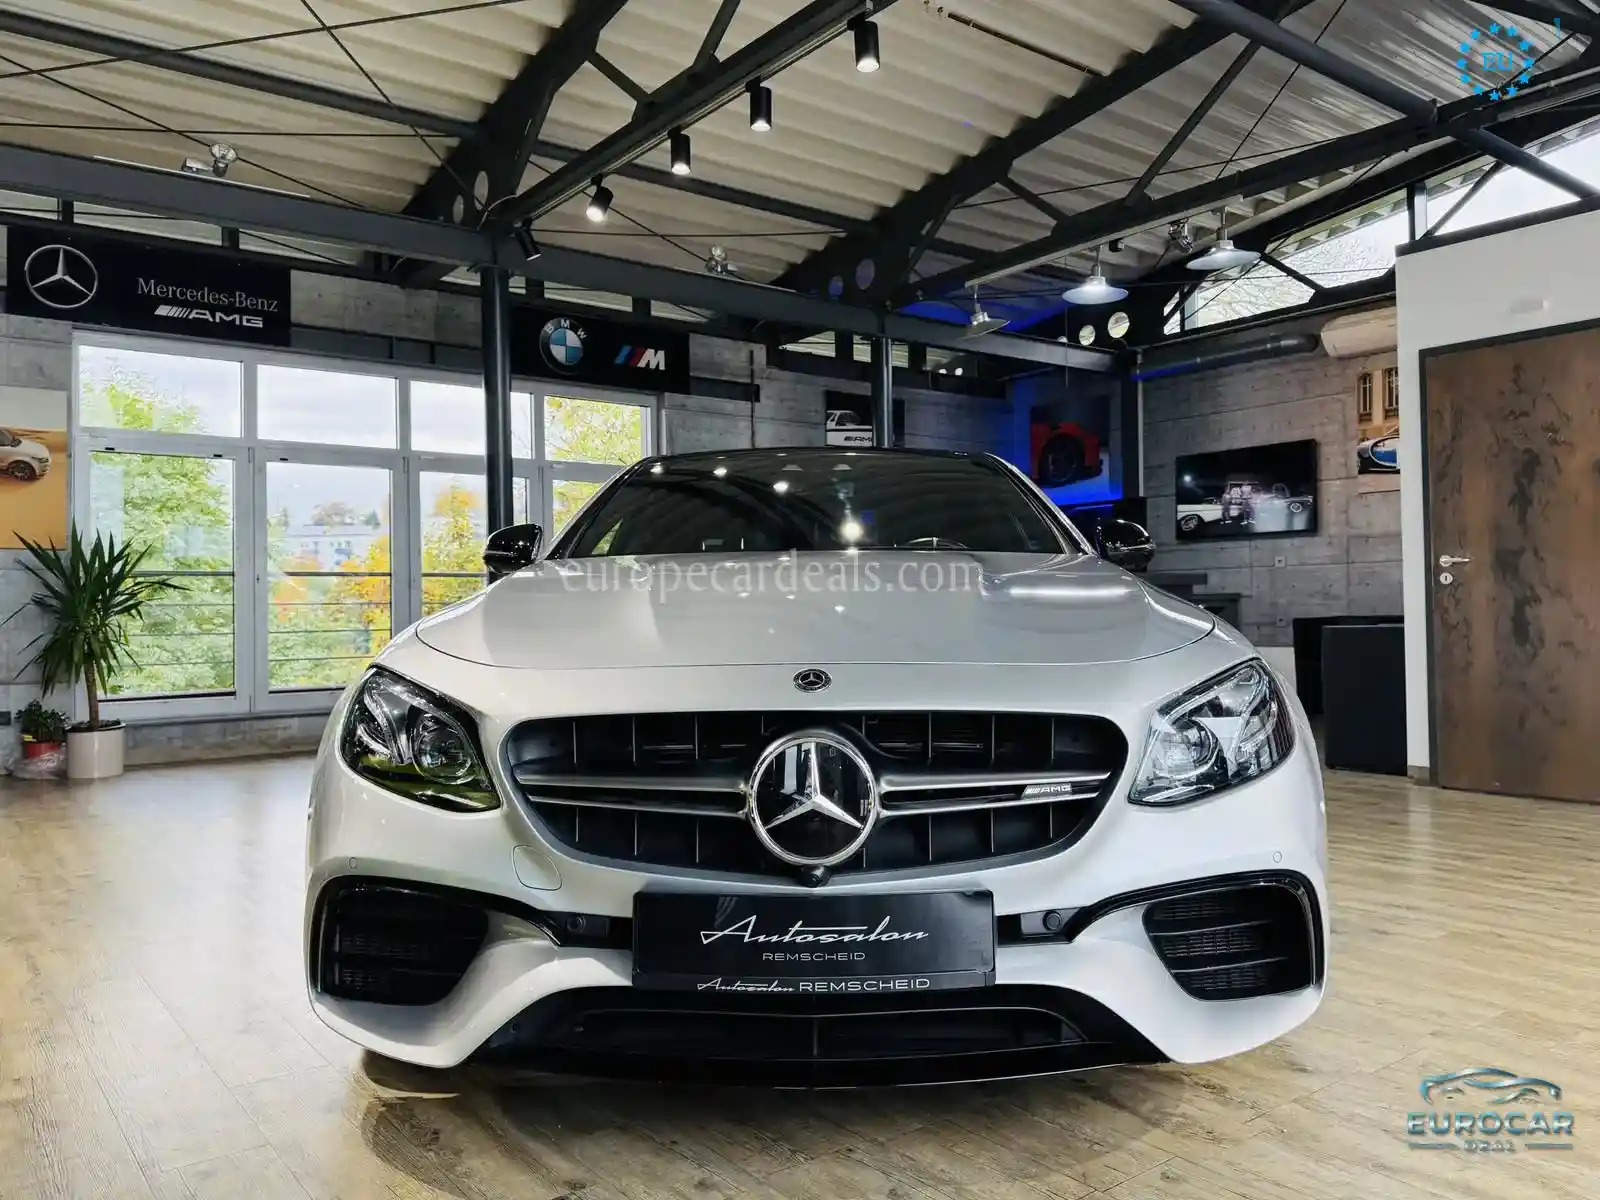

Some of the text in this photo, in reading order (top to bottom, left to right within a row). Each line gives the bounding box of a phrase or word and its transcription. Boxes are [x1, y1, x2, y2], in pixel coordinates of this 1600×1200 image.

[137, 277, 278, 312] Mercedes-Benz
[188, 309, 264, 328] AMG
[544, 318, 588, 340] BMW
[700, 914, 929, 945] Autosalon
[762, 952, 866, 961] REMSCHEID
[697, 977, 930, 992] Autosalon REMSCHEID
